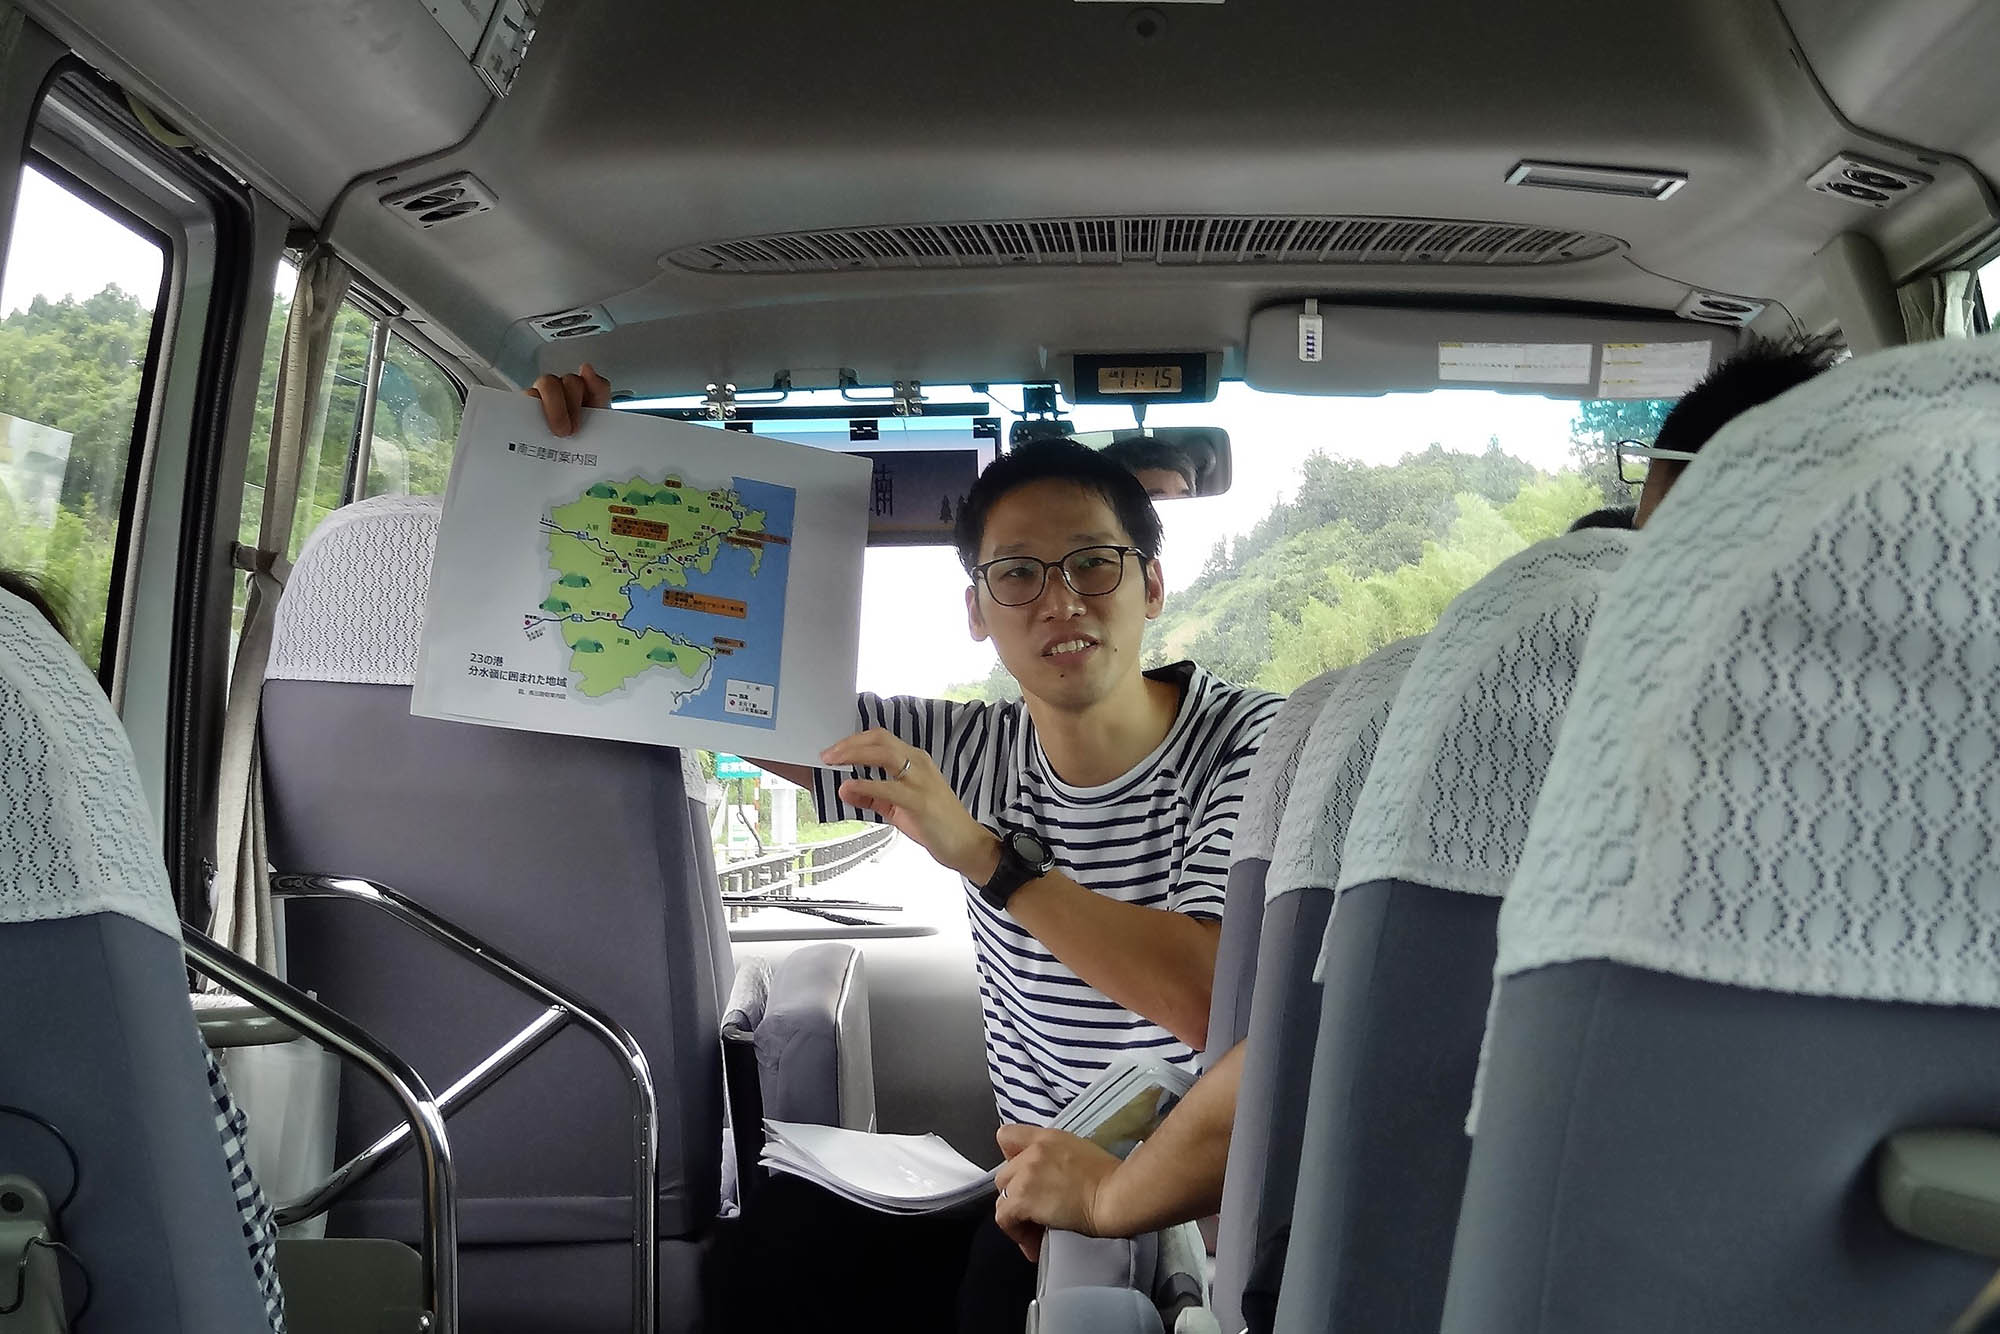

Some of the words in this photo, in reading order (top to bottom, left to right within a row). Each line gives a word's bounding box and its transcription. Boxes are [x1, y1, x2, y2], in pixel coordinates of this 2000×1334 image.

[470, 652, 504, 667] 23の港
[468, 665, 568, 688] 分水嶺に囲まれた地域
